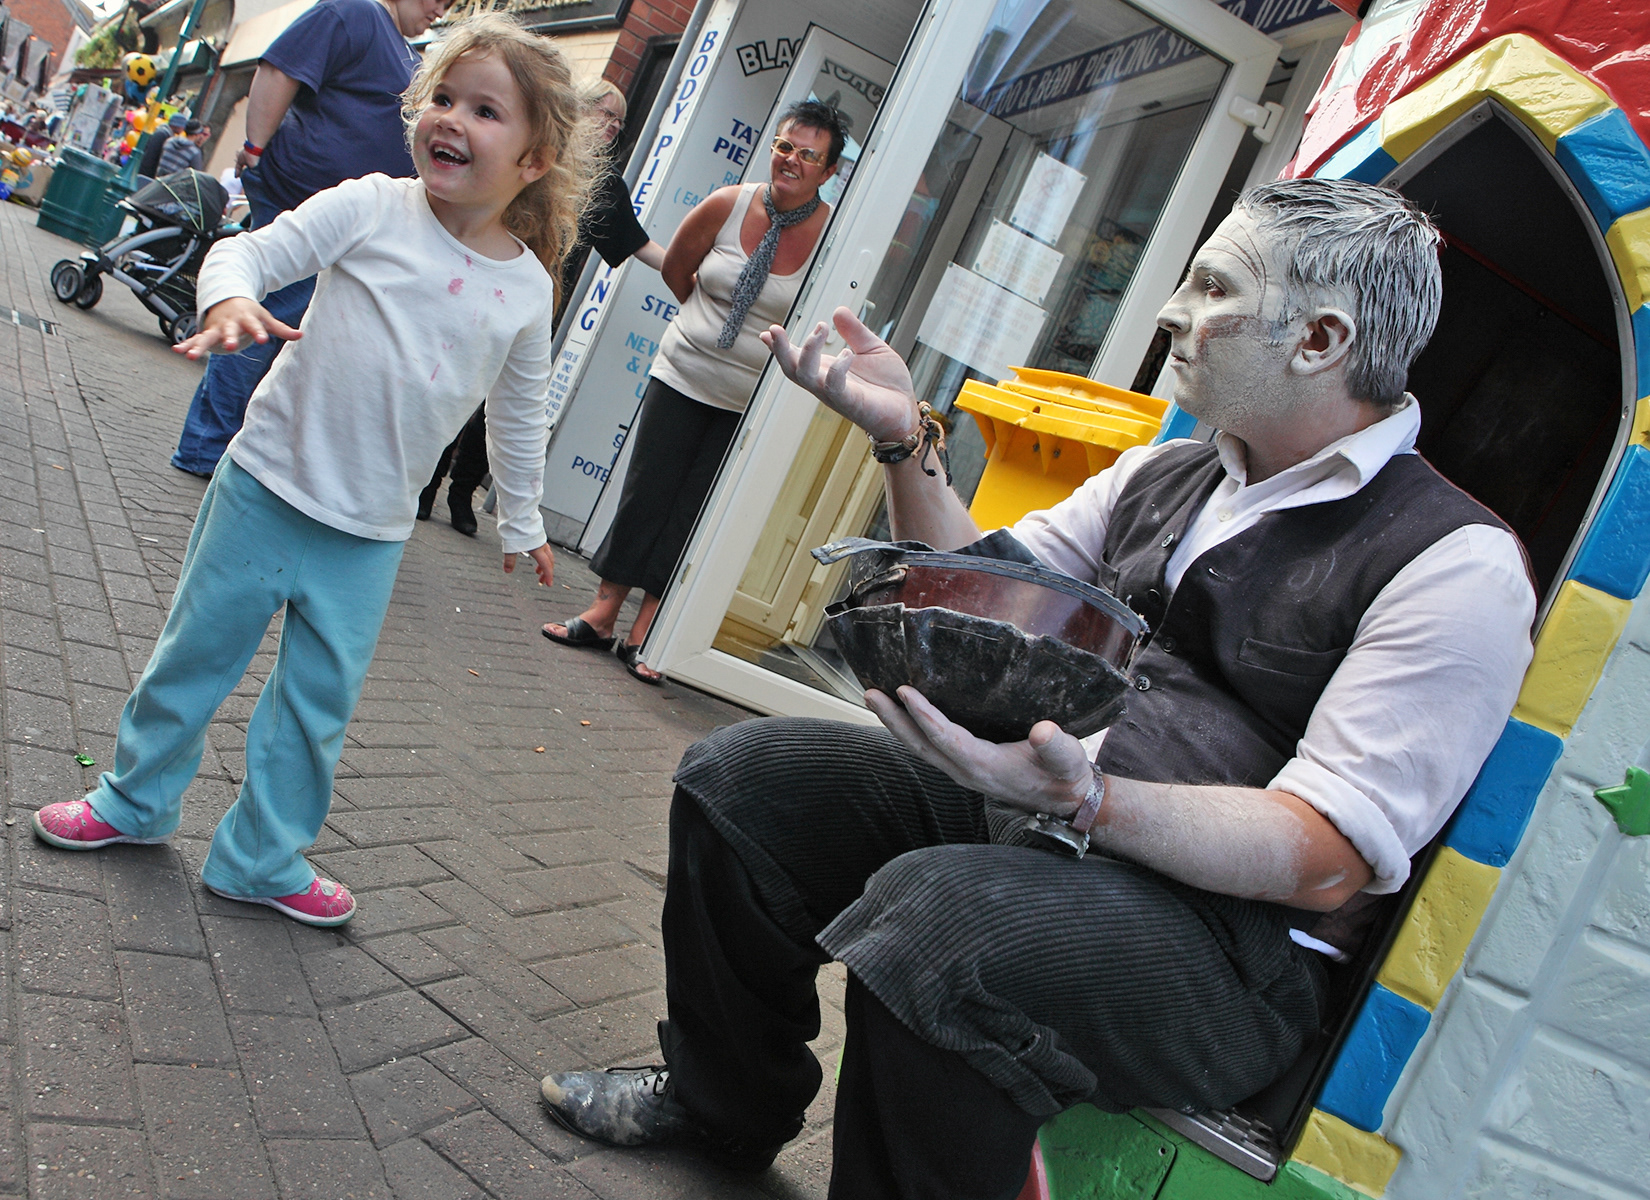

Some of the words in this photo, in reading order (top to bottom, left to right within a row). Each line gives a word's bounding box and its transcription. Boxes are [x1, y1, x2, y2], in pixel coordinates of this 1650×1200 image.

[672, 30, 719, 125] BODY
[1031, 58, 1085, 103] BODY
[1075, 28, 1168, 93] PIERCING
[641, 294, 680, 323] STE
